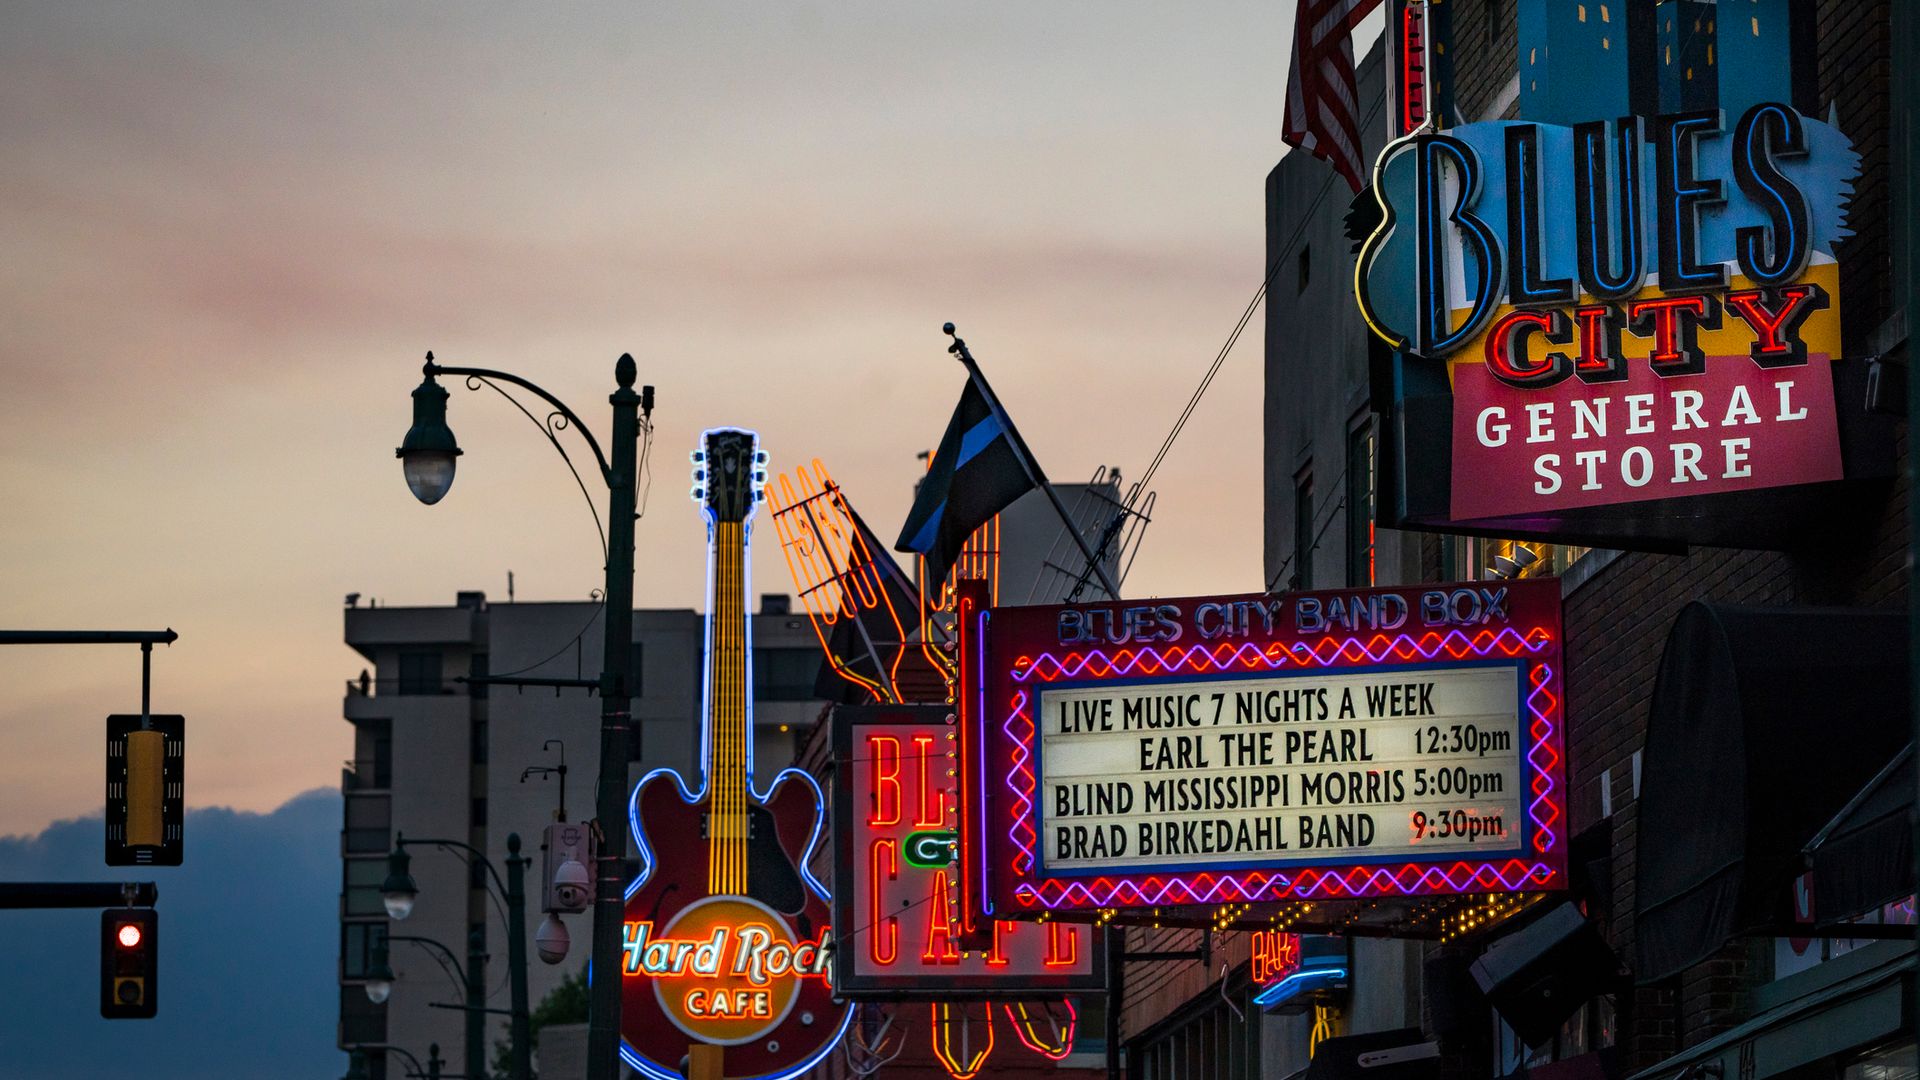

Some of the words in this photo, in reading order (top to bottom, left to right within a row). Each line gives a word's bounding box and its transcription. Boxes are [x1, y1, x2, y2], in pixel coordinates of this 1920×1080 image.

[1417, 102, 1813, 357] BLUES
[1485, 284, 1829, 389] CITY
[1475, 380, 1808, 448] GENERAL
[1533, 437, 1753, 495] STORE
[1058, 603, 1184, 646] BLUES
[1194, 599, 1282, 639] CITY
[1295, 592, 1408, 635] BAND
[1420, 586, 1510, 627] BOX
[1060, 698, 1114, 733] LIVE
[1122, 693, 1201, 731] MUSIC
[1211, 692, 1224, 726] 7
[1235, 687, 1329, 724] NIGHTS
[1337, 686, 1357, 719] A
[1364, 682, 1435, 718] WEEK
[1139, 736, 1209, 771] EARL
[1219, 731, 1274, 767] THE
[1285, 727, 1374, 764] PEARL
[1413, 723, 1512, 757] 12:30pm
[1055, 781, 1133, 817] BLIND
[1144, 774, 1289, 814] MISSISSIPPI
[1302, 768, 1405, 806] MORRIS
[1413, 766, 1503, 799] 5:00pm
[1056, 824, 1127, 860] BRAD
[1138, 816, 1288, 857] BIRKEDAHL
[1298, 812, 1375, 849] BAND
[1411, 810, 1503, 842] 9:30pm
[622, 921, 730, 978] Hard
[730, 922, 833, 989] Rock
[684, 987, 773, 1019] CAFE
